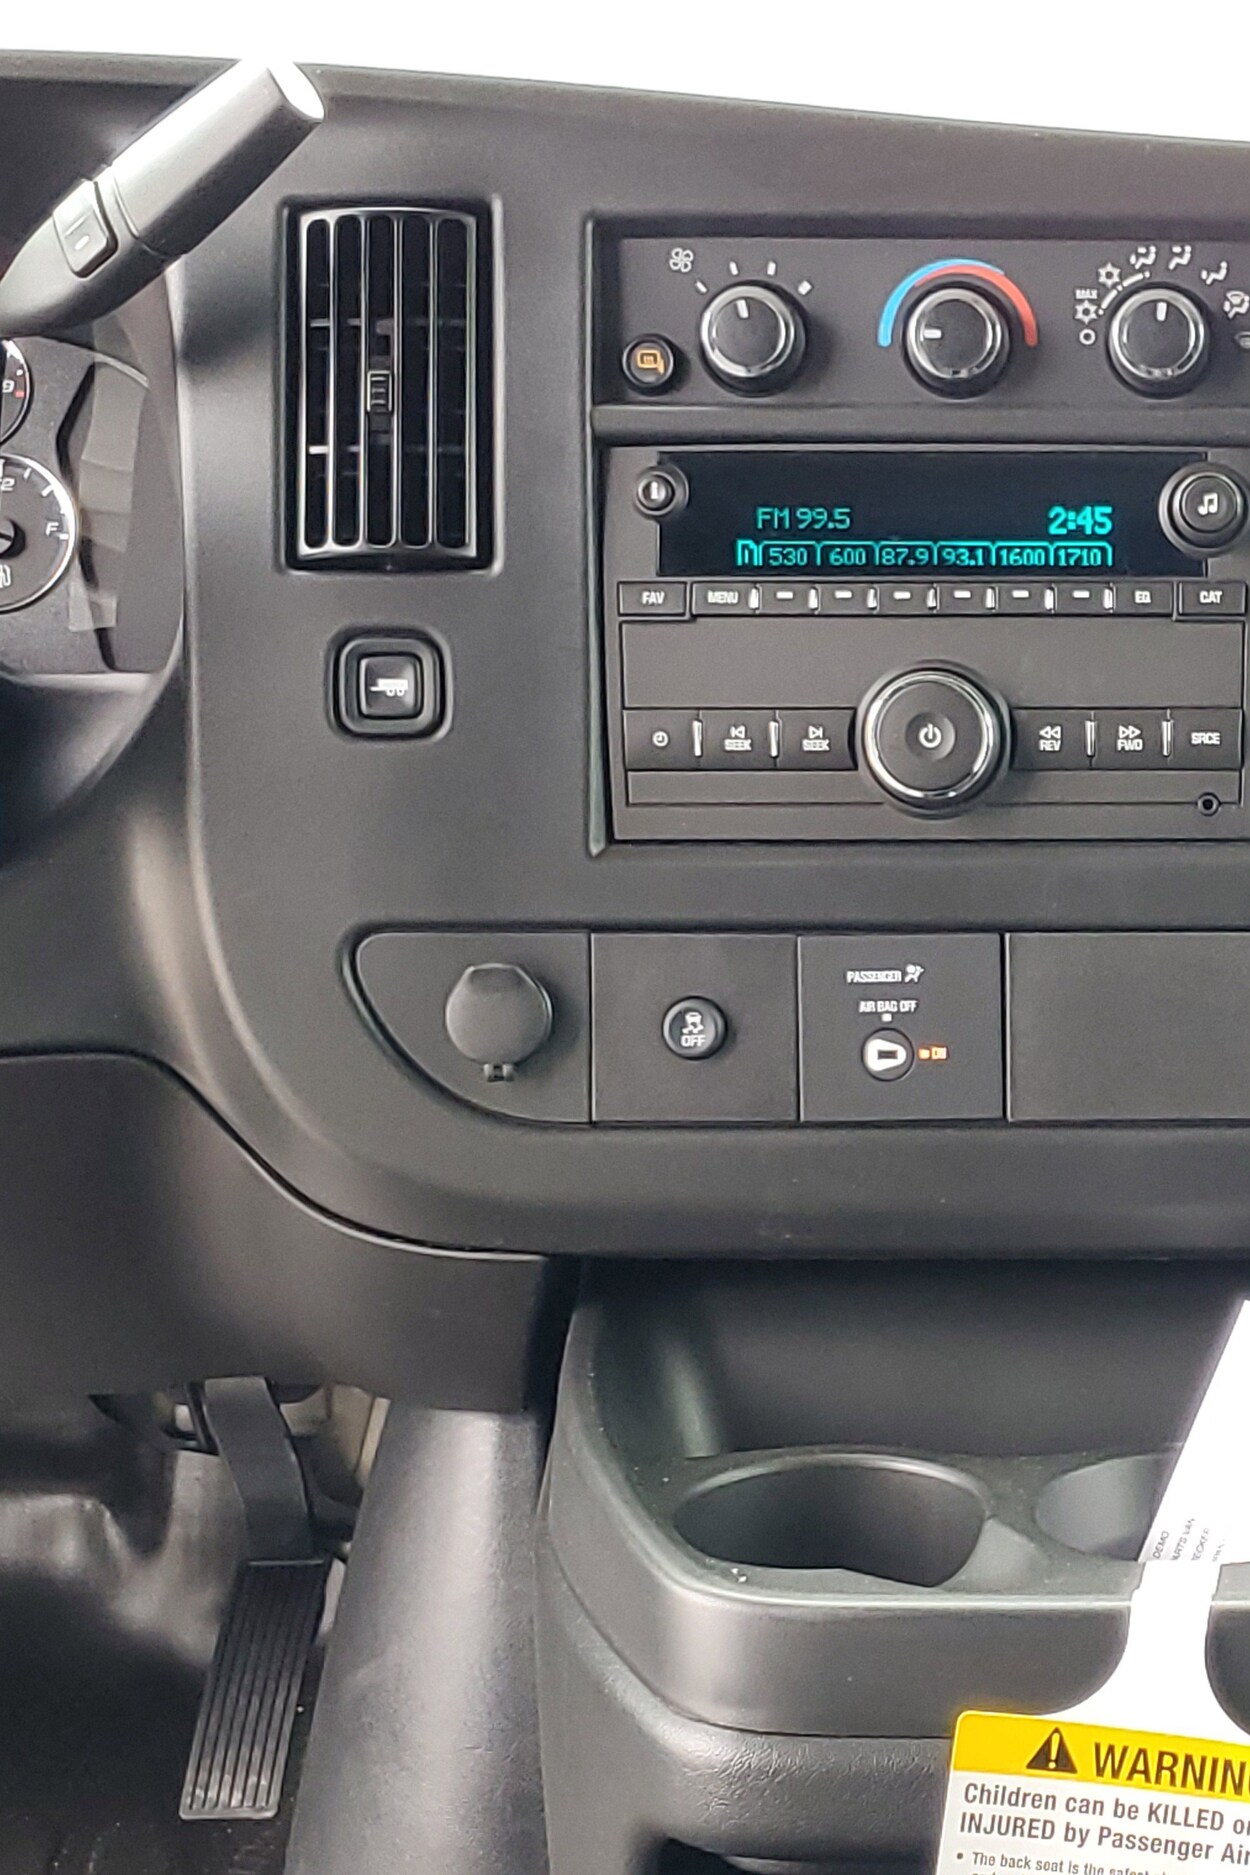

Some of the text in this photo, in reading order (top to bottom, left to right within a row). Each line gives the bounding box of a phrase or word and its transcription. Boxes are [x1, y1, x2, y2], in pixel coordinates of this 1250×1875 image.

[756, 507, 852, 530] FM 99.5
[1048, 505, 1113, 535] 2:45
[769, 547, 808, 566] 530
[829, 547, 867, 566] 600
[881, 547, 929, 566] 87.9
[942, 547, 984, 566] 93.1
[1000, 547, 1046, 566] 1600
[1058, 547, 1102, 566] 1710
[641, 590, 665, 605] FAV
[707, 590, 739, 604] MENU
[1134, 590, 1151, 604] EQ
[1199, 590, 1223, 604] CAT
[724, 738, 752, 751] SEEK
[802, 738, 830, 751] SEEK
[1039, 739, 1062, 751] REV
[1117, 739, 1144, 751] FWD
[1190, 732, 1221, 745] SRCE
[846, 970, 902, 983] PASSENGER
[859, 999, 918, 1013] AIR BAG OFF
[680, 1034, 706, 1048] OFF
[1153, 1530, 1170, 1559] DEMO
[964, 1782, 1057, 1811] Children
[1065, 1795, 1105, 1816] can
[1113, 1797, 1139, 1820] be
[1147, 1802, 1225, 1831] KILLED
[959, 1811, 1055, 1840] INJURED
[1063, 1821, 1090, 1848] by
[1097, 1825, 1214, 1861] Passenger
[972, 1851, 996, 1867] The
[1000, 1853, 1032, 1870] back
[1036, 1857, 1064, 1873] seat
[1068, 1860, 1080, 1875] is
